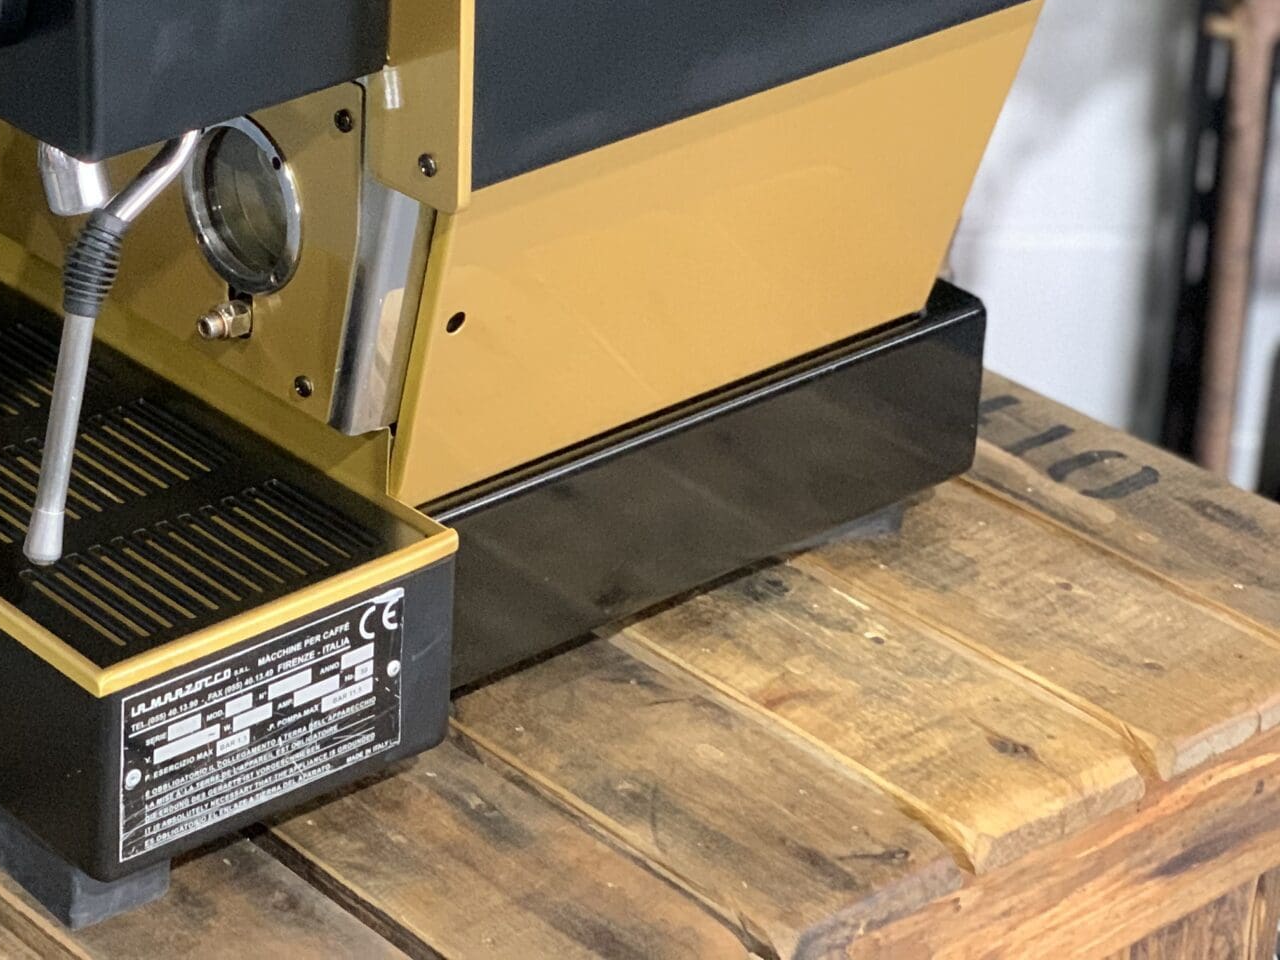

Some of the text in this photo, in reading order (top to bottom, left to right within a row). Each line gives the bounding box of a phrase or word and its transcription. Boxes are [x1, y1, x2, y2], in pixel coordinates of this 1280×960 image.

[358, 599, 399, 640] CE
[206, 688, 223, 702] FAX
[276, 649, 315, 673] FIRENZE
[322, 634, 350, 655] ITALIA
[257, 640, 302, 667] MACCHINE
[303, 632, 321, 648] PER
[205, 707, 225, 722] MOD.
[319, 660, 339, 675] ANNO
[153, 754, 195, 779] ESERCIZIO
[196, 746, 213, 762] MAX
[276, 710, 302, 728] POMPA
[302, 702, 319, 717] MAX
[283, 723, 307, 741] TERRA
[364, 745, 372, 756] IN
